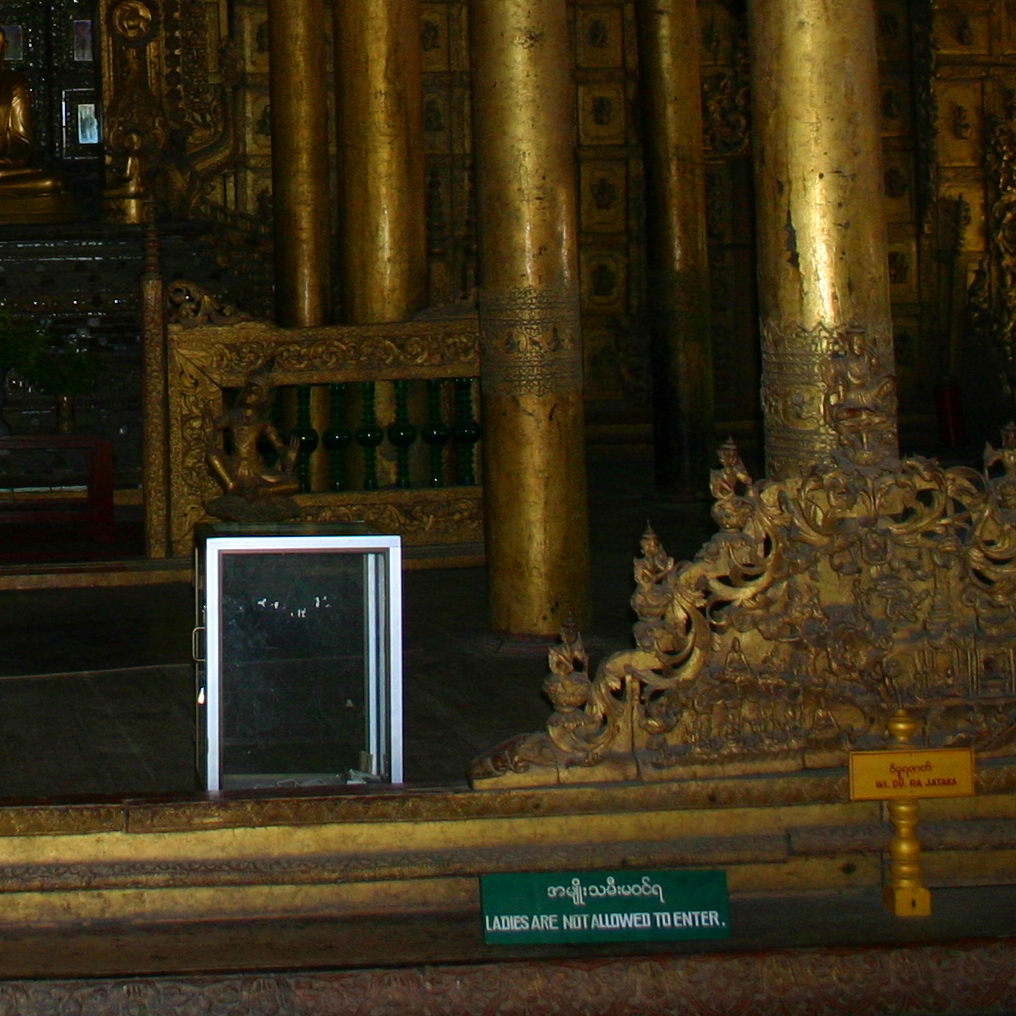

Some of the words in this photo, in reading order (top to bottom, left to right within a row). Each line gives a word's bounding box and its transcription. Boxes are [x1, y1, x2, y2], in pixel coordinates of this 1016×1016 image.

[485, 914, 530, 931] LADIES
[530, 914, 559, 930] ARE
[562, 913, 590, 930] NOT
[590, 912, 652, 929] ALLOWED
[653, 911, 672, 928] TO
[672, 910, 727, 928] ENTER.
